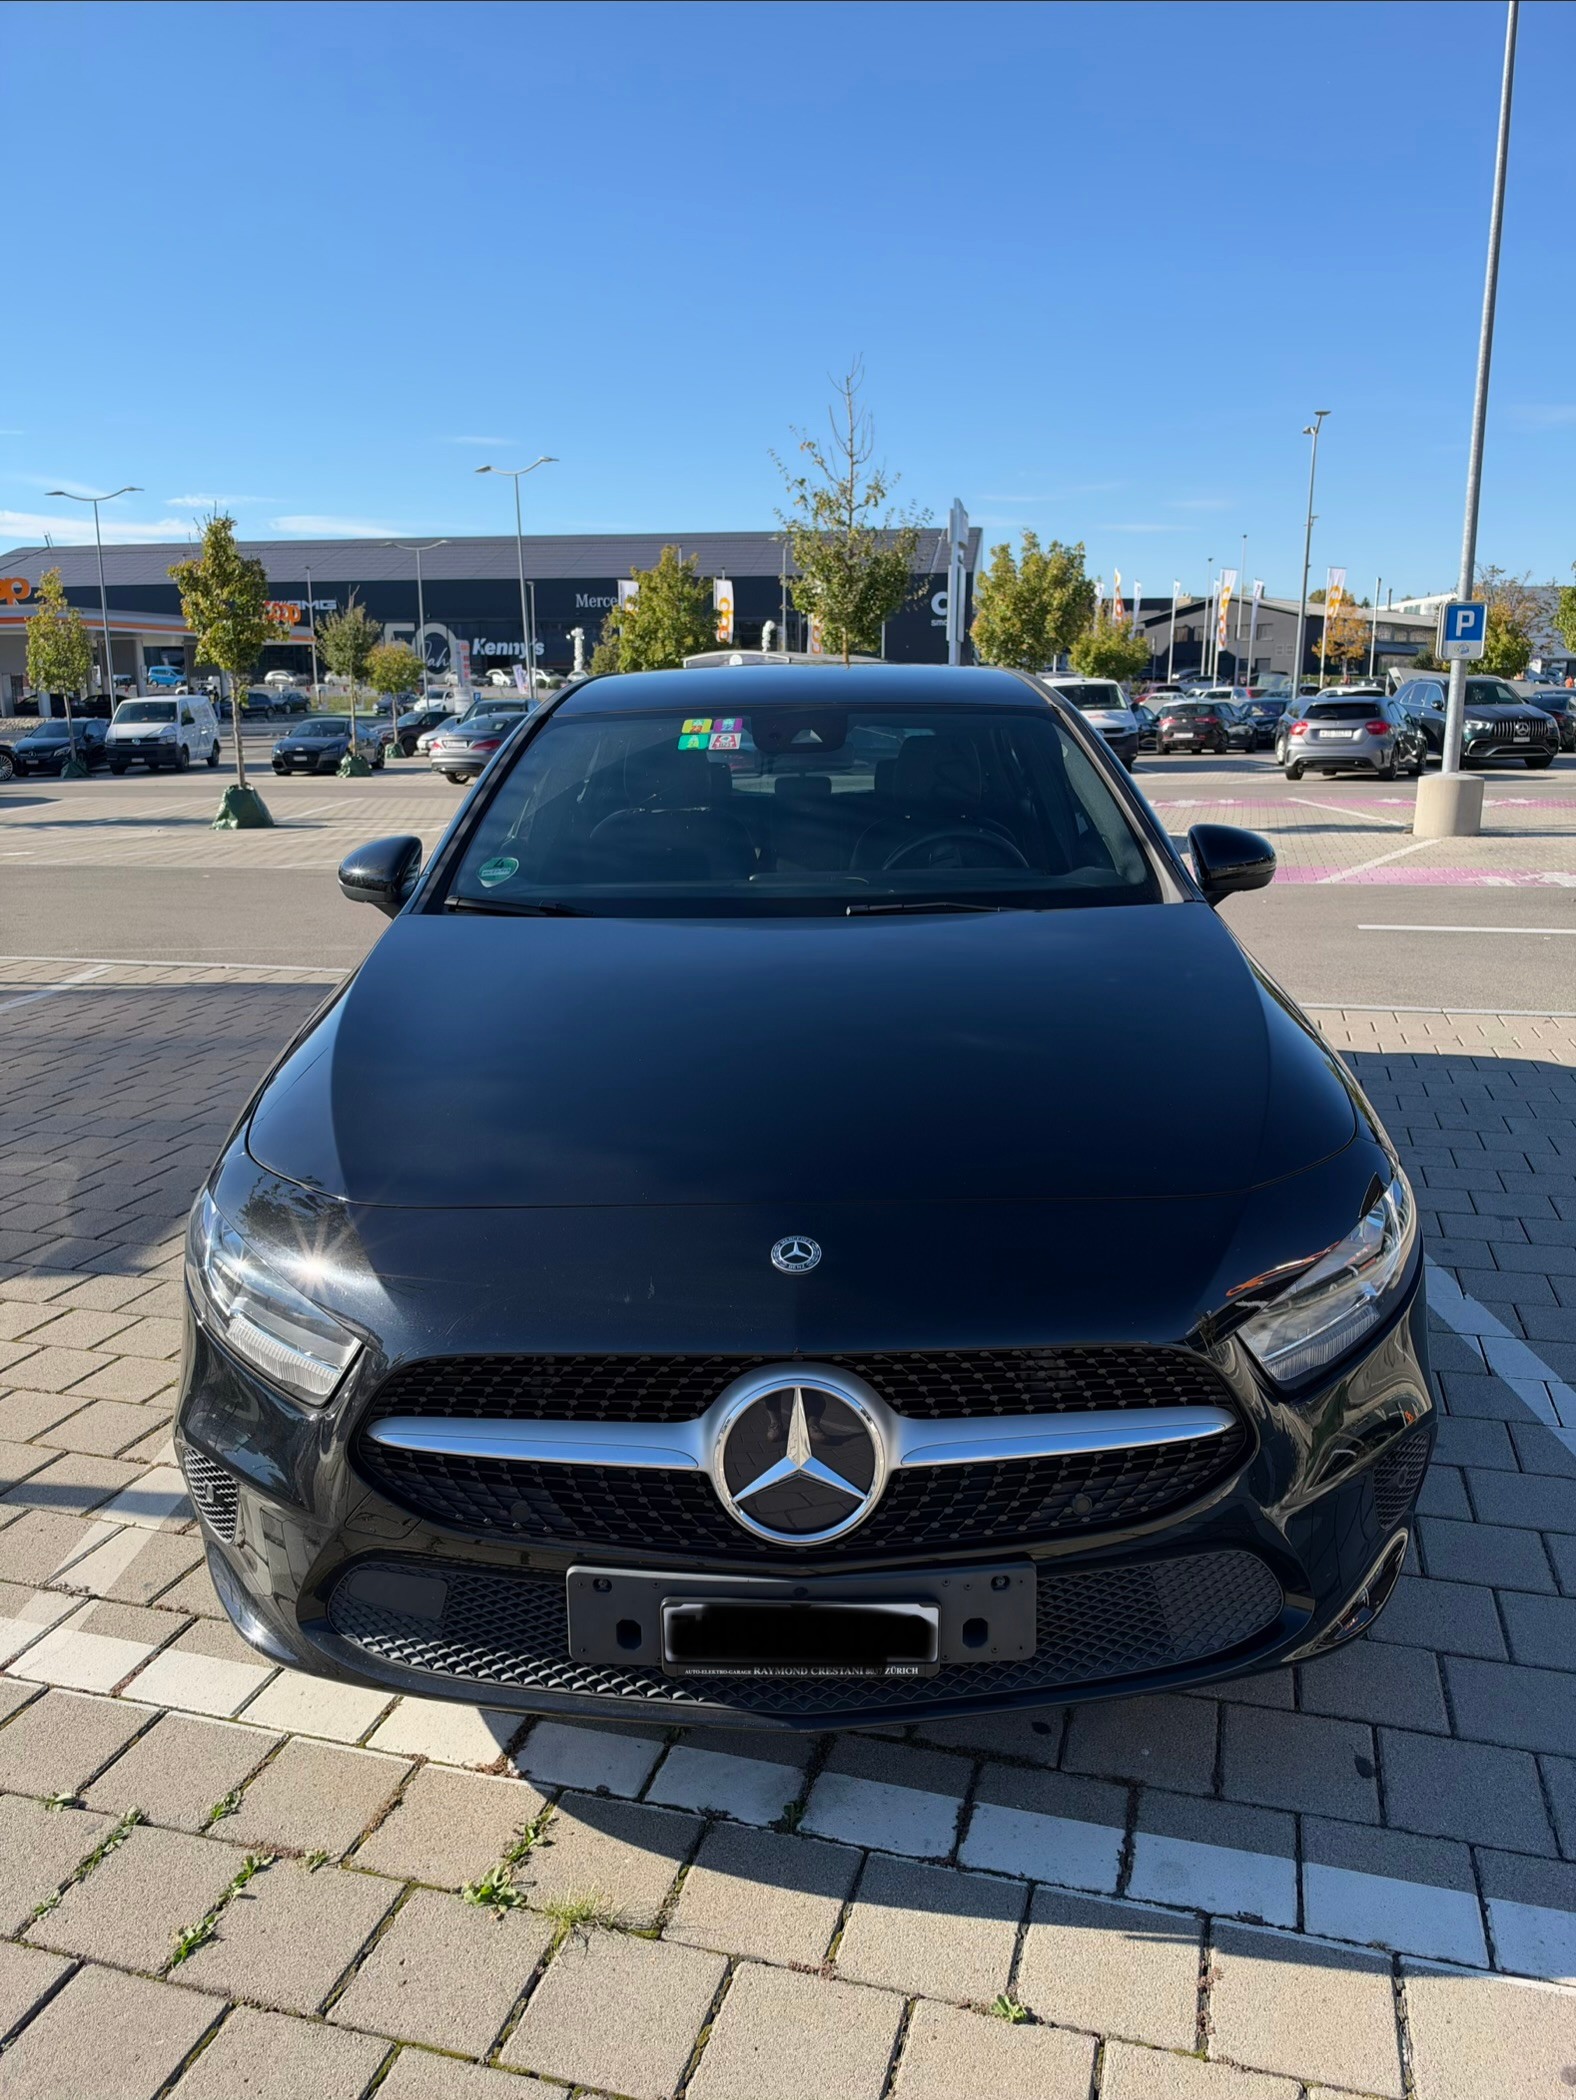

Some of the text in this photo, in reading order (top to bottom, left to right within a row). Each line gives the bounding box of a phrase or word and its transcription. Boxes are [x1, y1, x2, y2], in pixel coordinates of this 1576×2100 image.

[1455, 610, 1475, 637] P
[472, 638, 545, 659] Kenny's
[493, 858, 505, 868] 4
[753, 1666, 808, 1676] RAYMOND
[810, 1666, 864, 1676] CRESTANI
[884, 1665, 919, 1675] ZÜRICH
